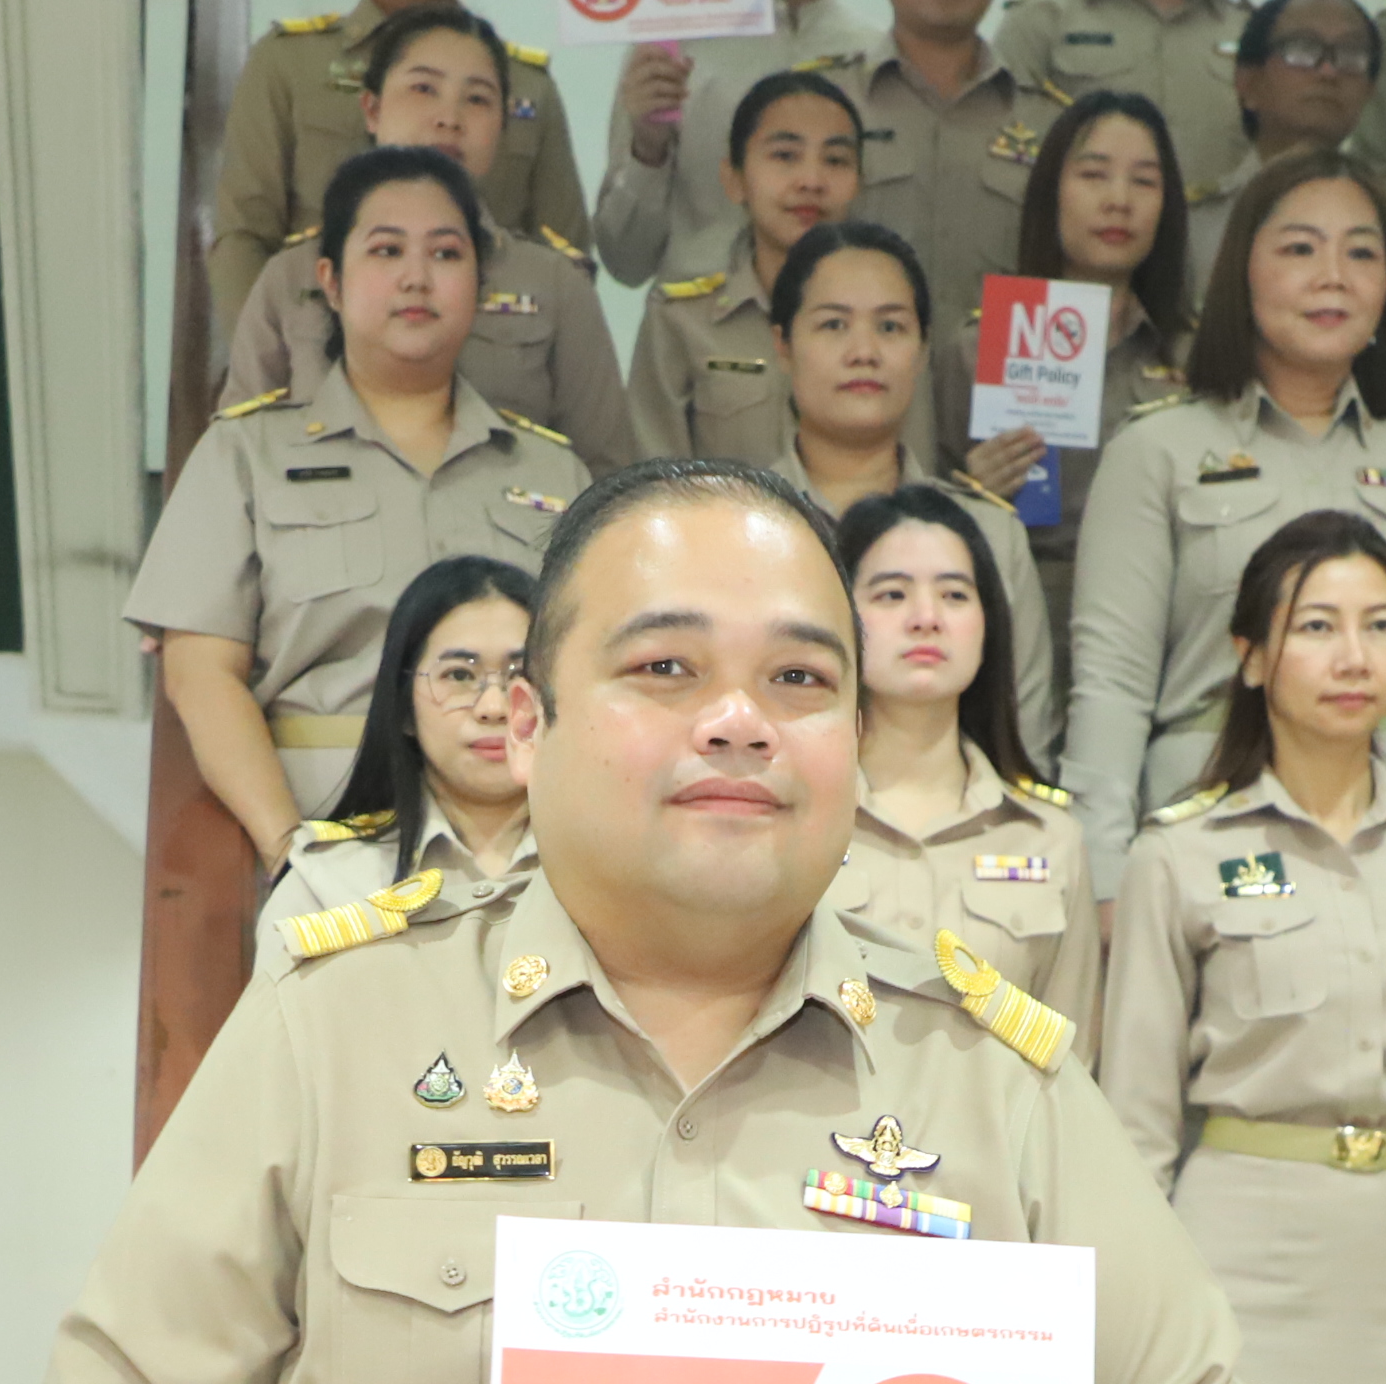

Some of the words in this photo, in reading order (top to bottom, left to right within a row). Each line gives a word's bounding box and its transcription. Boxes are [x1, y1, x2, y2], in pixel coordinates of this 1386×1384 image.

[1007, 361, 1033, 381] Gift
[1036, 364, 1082, 391] Policy
[652, 1276, 836, 1307] สำนักกฎหมาย
[654, 1307, 1053, 1342] สำนักงานการปฏิรูปที่ดินเพื่อเกษตรกรรม
